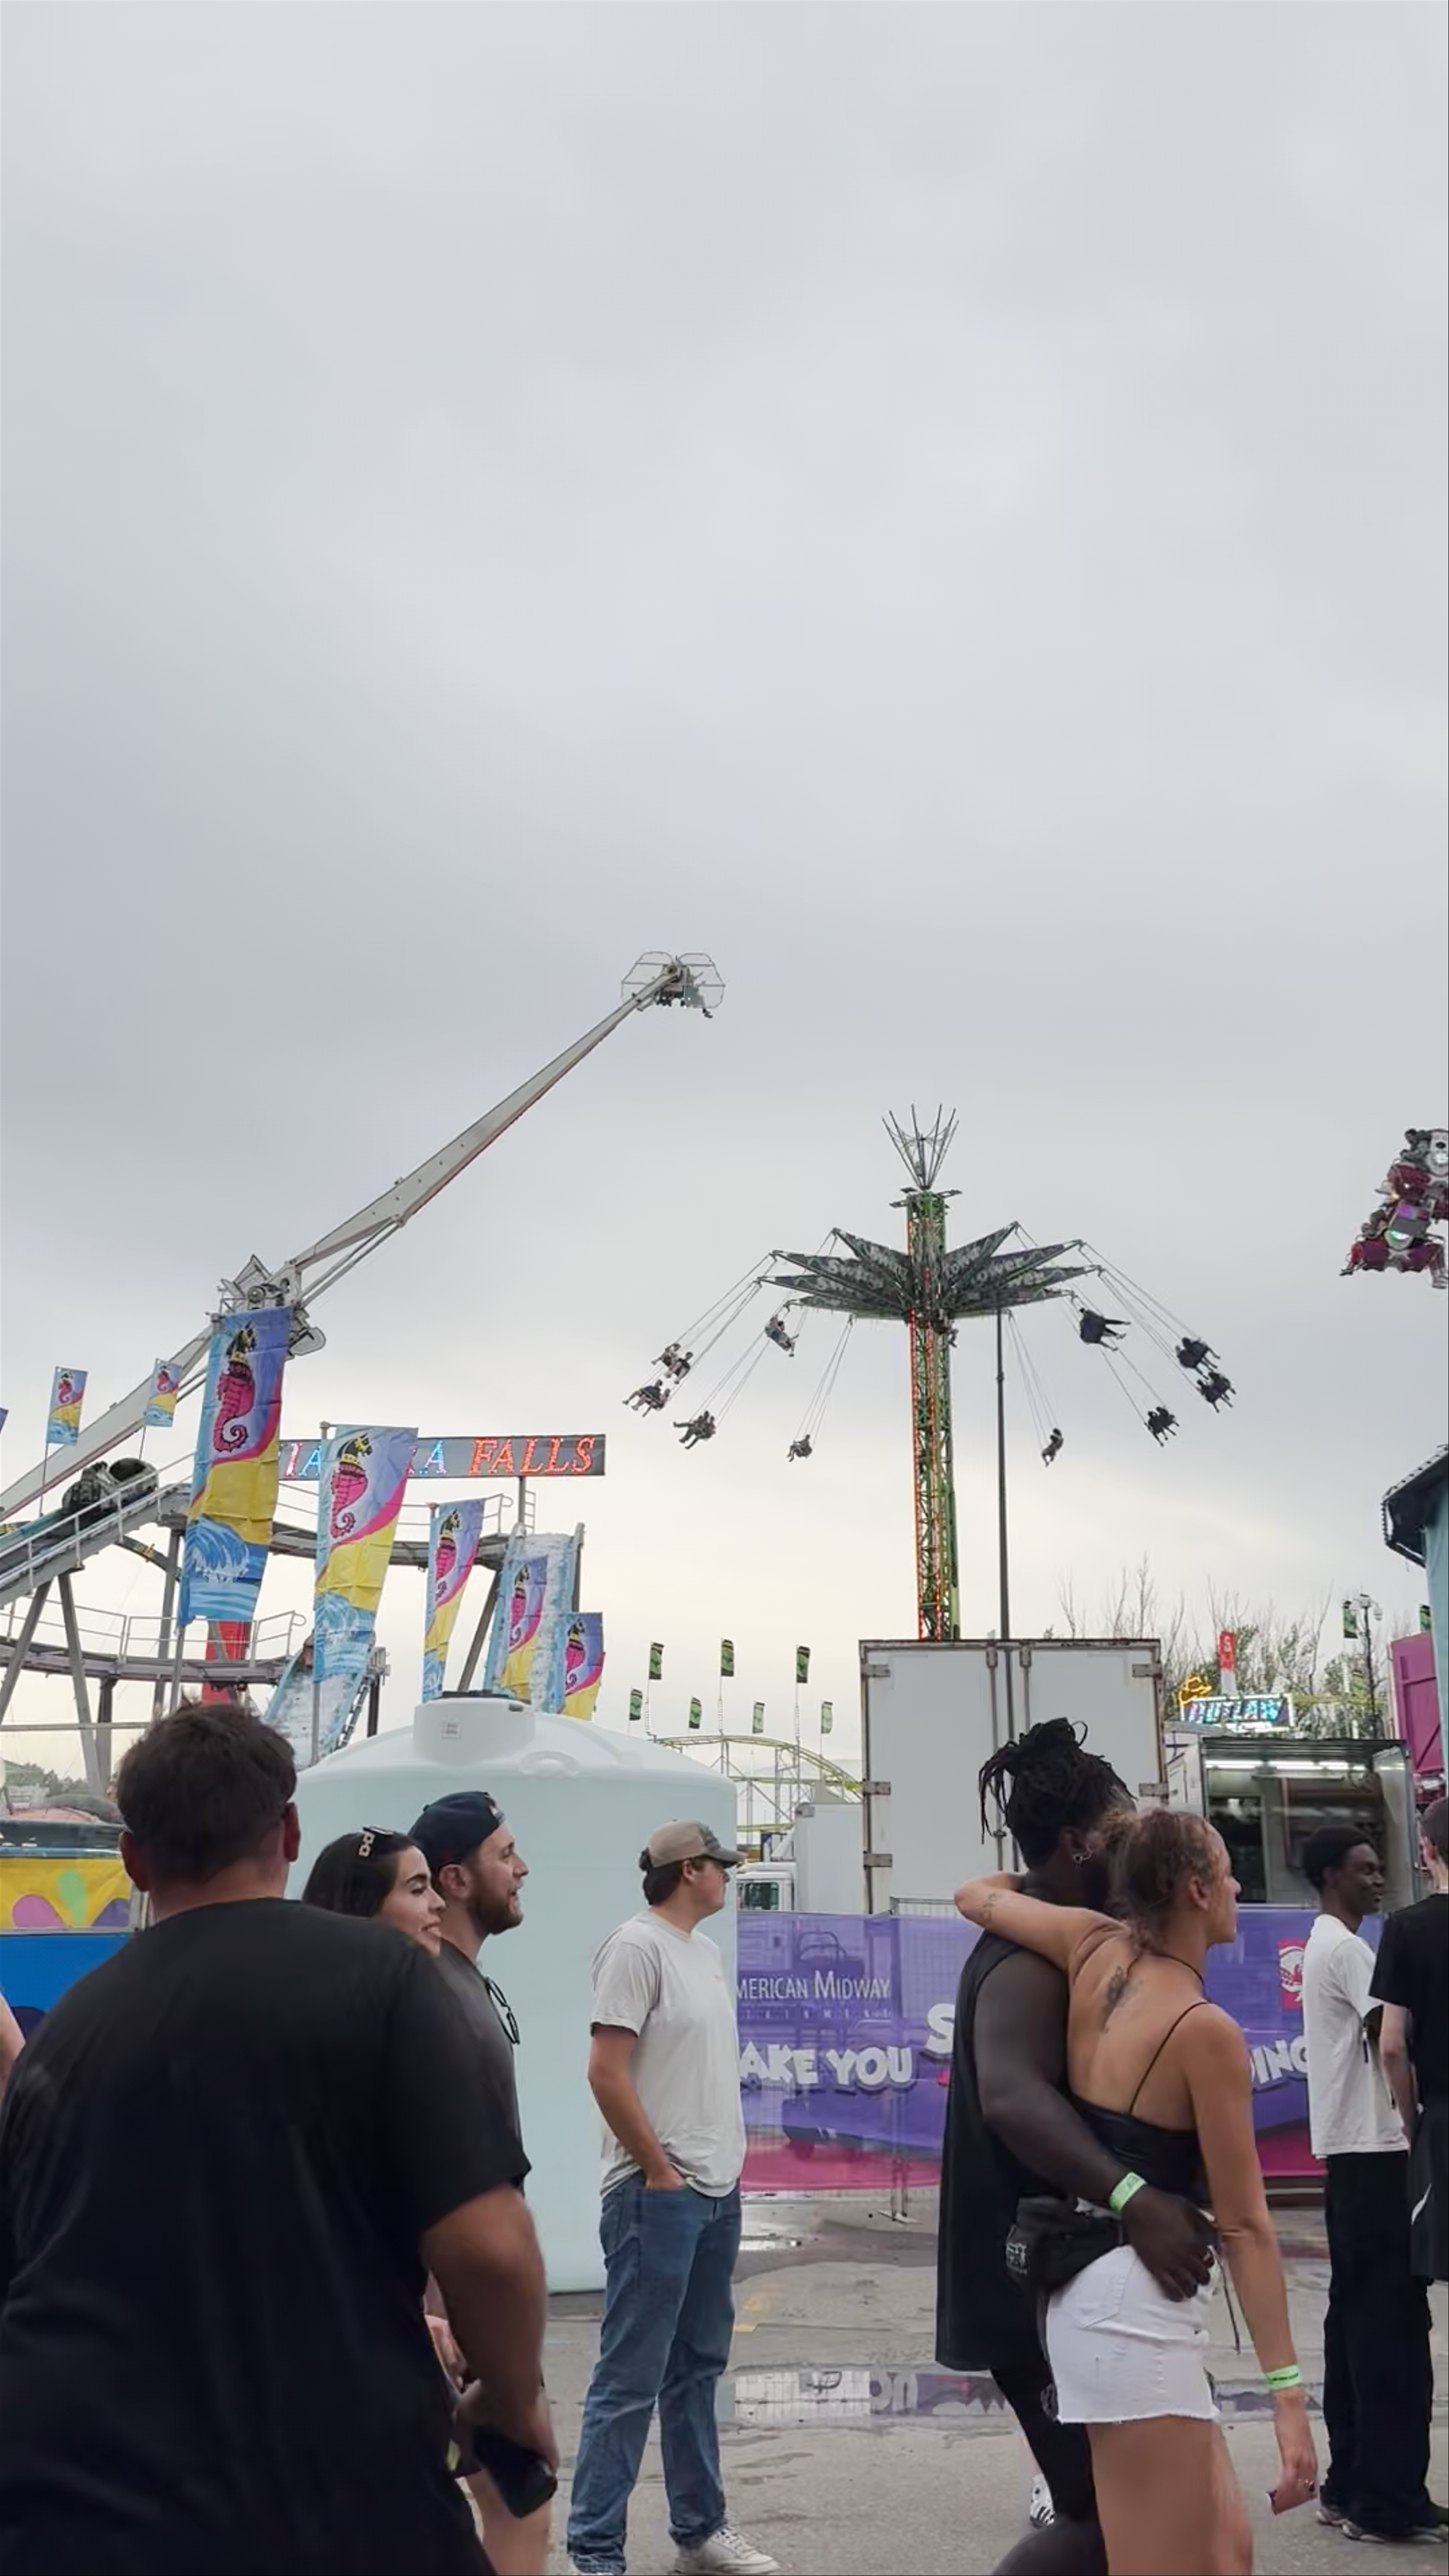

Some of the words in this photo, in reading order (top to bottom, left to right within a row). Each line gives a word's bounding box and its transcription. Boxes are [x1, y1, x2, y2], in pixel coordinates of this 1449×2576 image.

[468, 1435, 595, 1475] FALLS
[737, 1977, 808, 1999] MERICAN
[814, 1970, 891, 1999] MIDWAY
[740, 2041, 818, 2084] AKE
[826, 2046, 912, 2085] YOU
